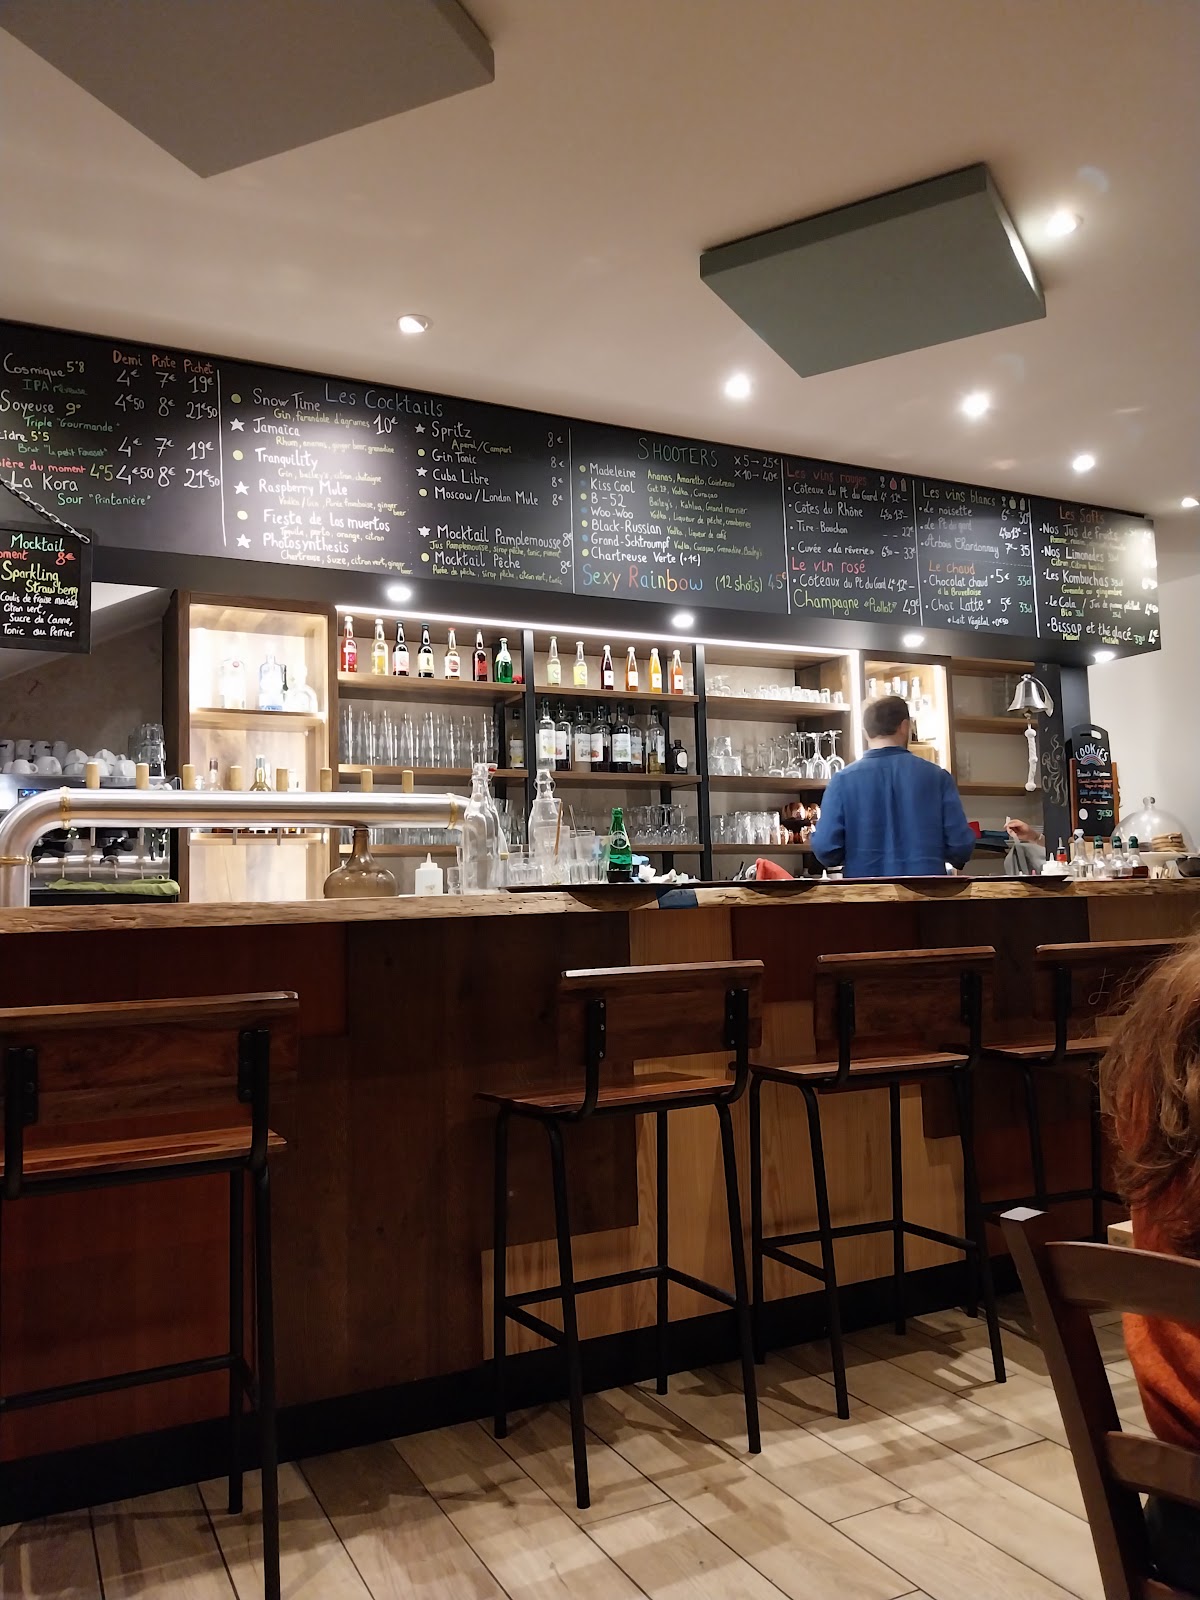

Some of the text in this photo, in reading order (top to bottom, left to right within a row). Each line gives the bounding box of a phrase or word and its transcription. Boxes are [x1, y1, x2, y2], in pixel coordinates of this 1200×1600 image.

[113, 350, 214, 374] Demi Pinte Pichet
[3, 352, 214, 394] Cosmique 4€ 7€ 19€
[22, 378, 49, 391] IPA
[0, 389, 55, 417] Soyeuse
[114, 394, 145, 412] 4€50
[158, 396, 176, 417] 8€
[185, 401, 218, 420] 21€50
[253, 388, 320, 412] Snow Time
[326, 382, 443, 417] Les Cocktails
[24, 415, 53, 430] Triple
[253, 417, 300, 437] Jamaïca
[373, 413, 398, 435] 10€
[432, 420, 472, 442] Spritz
[118, 436, 214, 460] 4€ 7€ 19€
[432, 448, 453, 463] Gin
[454, 451, 477, 465] Tonic
[637, 437, 718, 467] SHOOTERS
[255, 447, 318, 470] Tranquility
[29, 460, 220, 489] du moment 4€50 8€ 21€50
[432, 468, 564, 488] Cuba Libre 8€
[589, 463, 636, 478] Madeleine
[786, 462, 867, 488] Les vins rouges
[11, 471, 78, 491] La Kora
[259, 478, 348, 497] Raspberry Mule
[590, 477, 611, 491] Kiss
[614, 480, 636, 493] Cool
[793, 481, 824, 495] Côteaux
[828, 484, 836, 496] du
[852, 489, 860, 500] du
[58, 493, 83, 505] Sour
[515, 491, 564, 506] Mule 8€
[923, 483, 996, 506] Les vins blancs
[590, 506, 634, 519] Woo-Woo
[794, 501, 864, 517] Côtes du Rhône
[939, 505, 972, 517] noisette
[1060, 506, 1105, 524] Les Softs
[263, 508, 390, 532] Fiesta de los muertos
[591, 518, 662, 535] Black-Russian
[437, 524, 489, 543] Mocktail
[495, 528, 561, 550] Pamplemousse
[1042, 523, 1059, 535] Nos
[1063, 524, 1079, 537] Jus
[1082, 527, 1092, 540] de
[1095, 526, 1119, 541] fruits
[10, 533, 65, 552] Mocktail
[263, 532, 349, 554] Photosynthesis
[429, 540, 443, 550] Jus
[591, 532, 670, 553] Grand-Schtroumpf
[798, 541, 821, 553] Cuvée
[925, 533, 999, 559] Arbois Chardonnay
[56, 552, 76, 565] 8€
[434, 551, 572, 574] Mocktail Pêche 8€
[591, 547, 648, 563] Chartreuse
[653, 551, 677, 564] Verte
[1044, 546, 1104, 562] Nos Limonades
[1, 560, 60, 587] Sparkling
[791, 556, 866, 574] Le vin rosé
[929, 561, 976, 575] Le chaud
[582, 563, 787, 593] Sexy Rainbow (12 shots) 45€
[843, 577, 852, 589] du
[855, 577, 865, 589] Pt
[865, 578, 873, 589] du
[929, 568, 1010, 587] Chocolat chaud 5€
[1046, 568, 1109, 587] Les Kombuchas
[23, 594, 31, 603] de
[793, 588, 859, 615] Champagne
[960, 597, 1012, 612] Latte 5€
[1049, 595, 1076, 609] Le Cola
[9, 613, 31, 623] Sucre
[1061, 608, 1072, 617] Bio
[3, 623, 75, 637] Tonic Perrier
[1050, 617, 1160, 644] Bissap et thé glacé 4€
